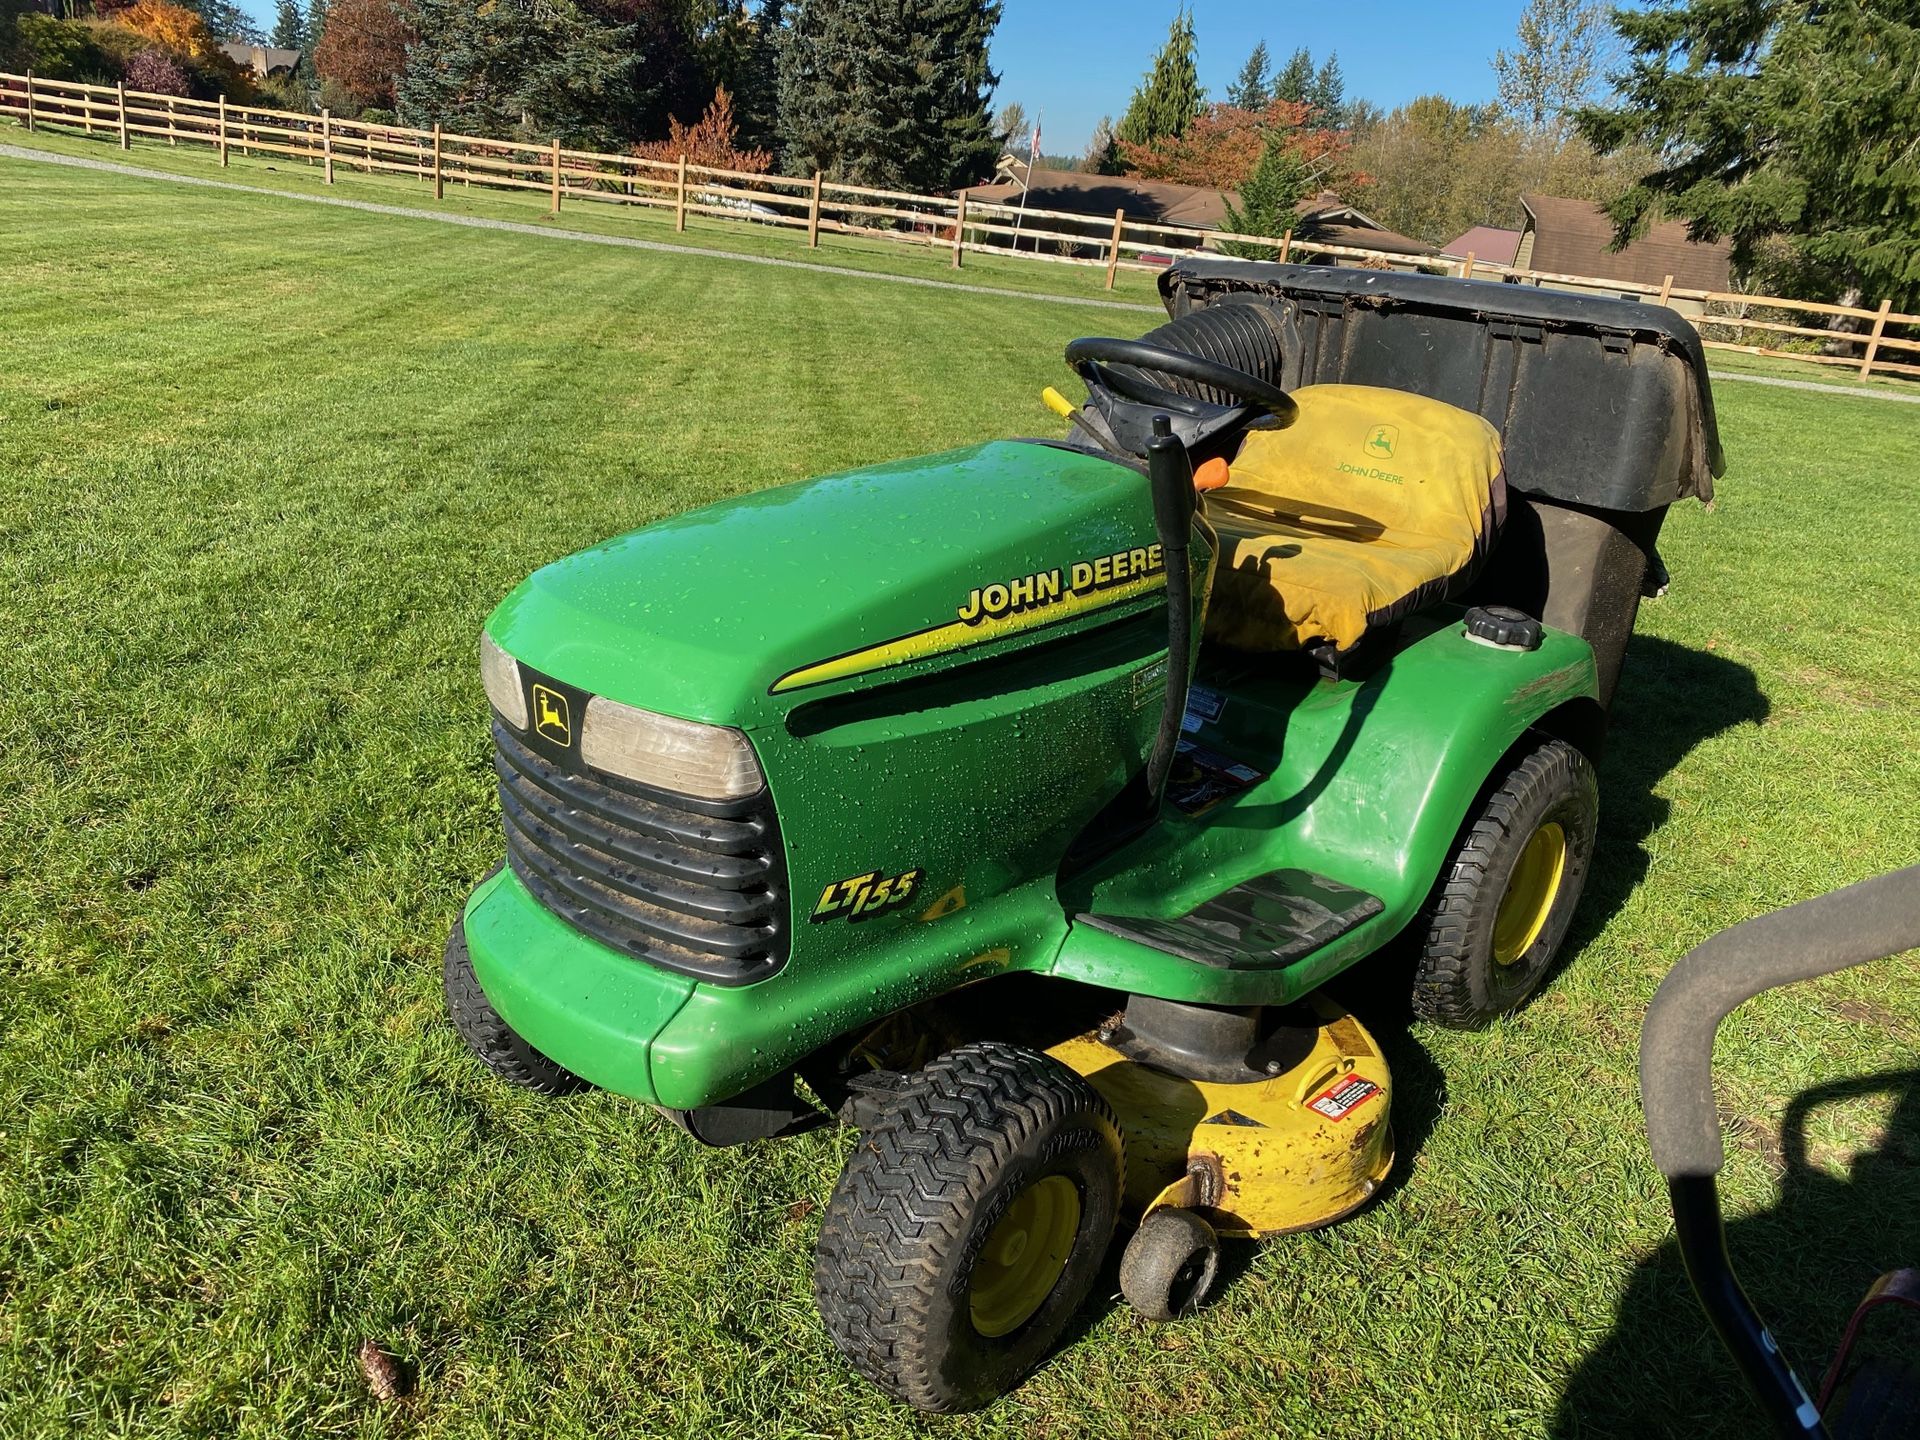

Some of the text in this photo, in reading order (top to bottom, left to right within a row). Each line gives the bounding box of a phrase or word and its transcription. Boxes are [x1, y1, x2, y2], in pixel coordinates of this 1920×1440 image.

[1335, 462, 1404, 485] JOHN DEERE
[958, 544, 1166, 624] JOHN DEERE
[812, 869, 921, 919] LT155
